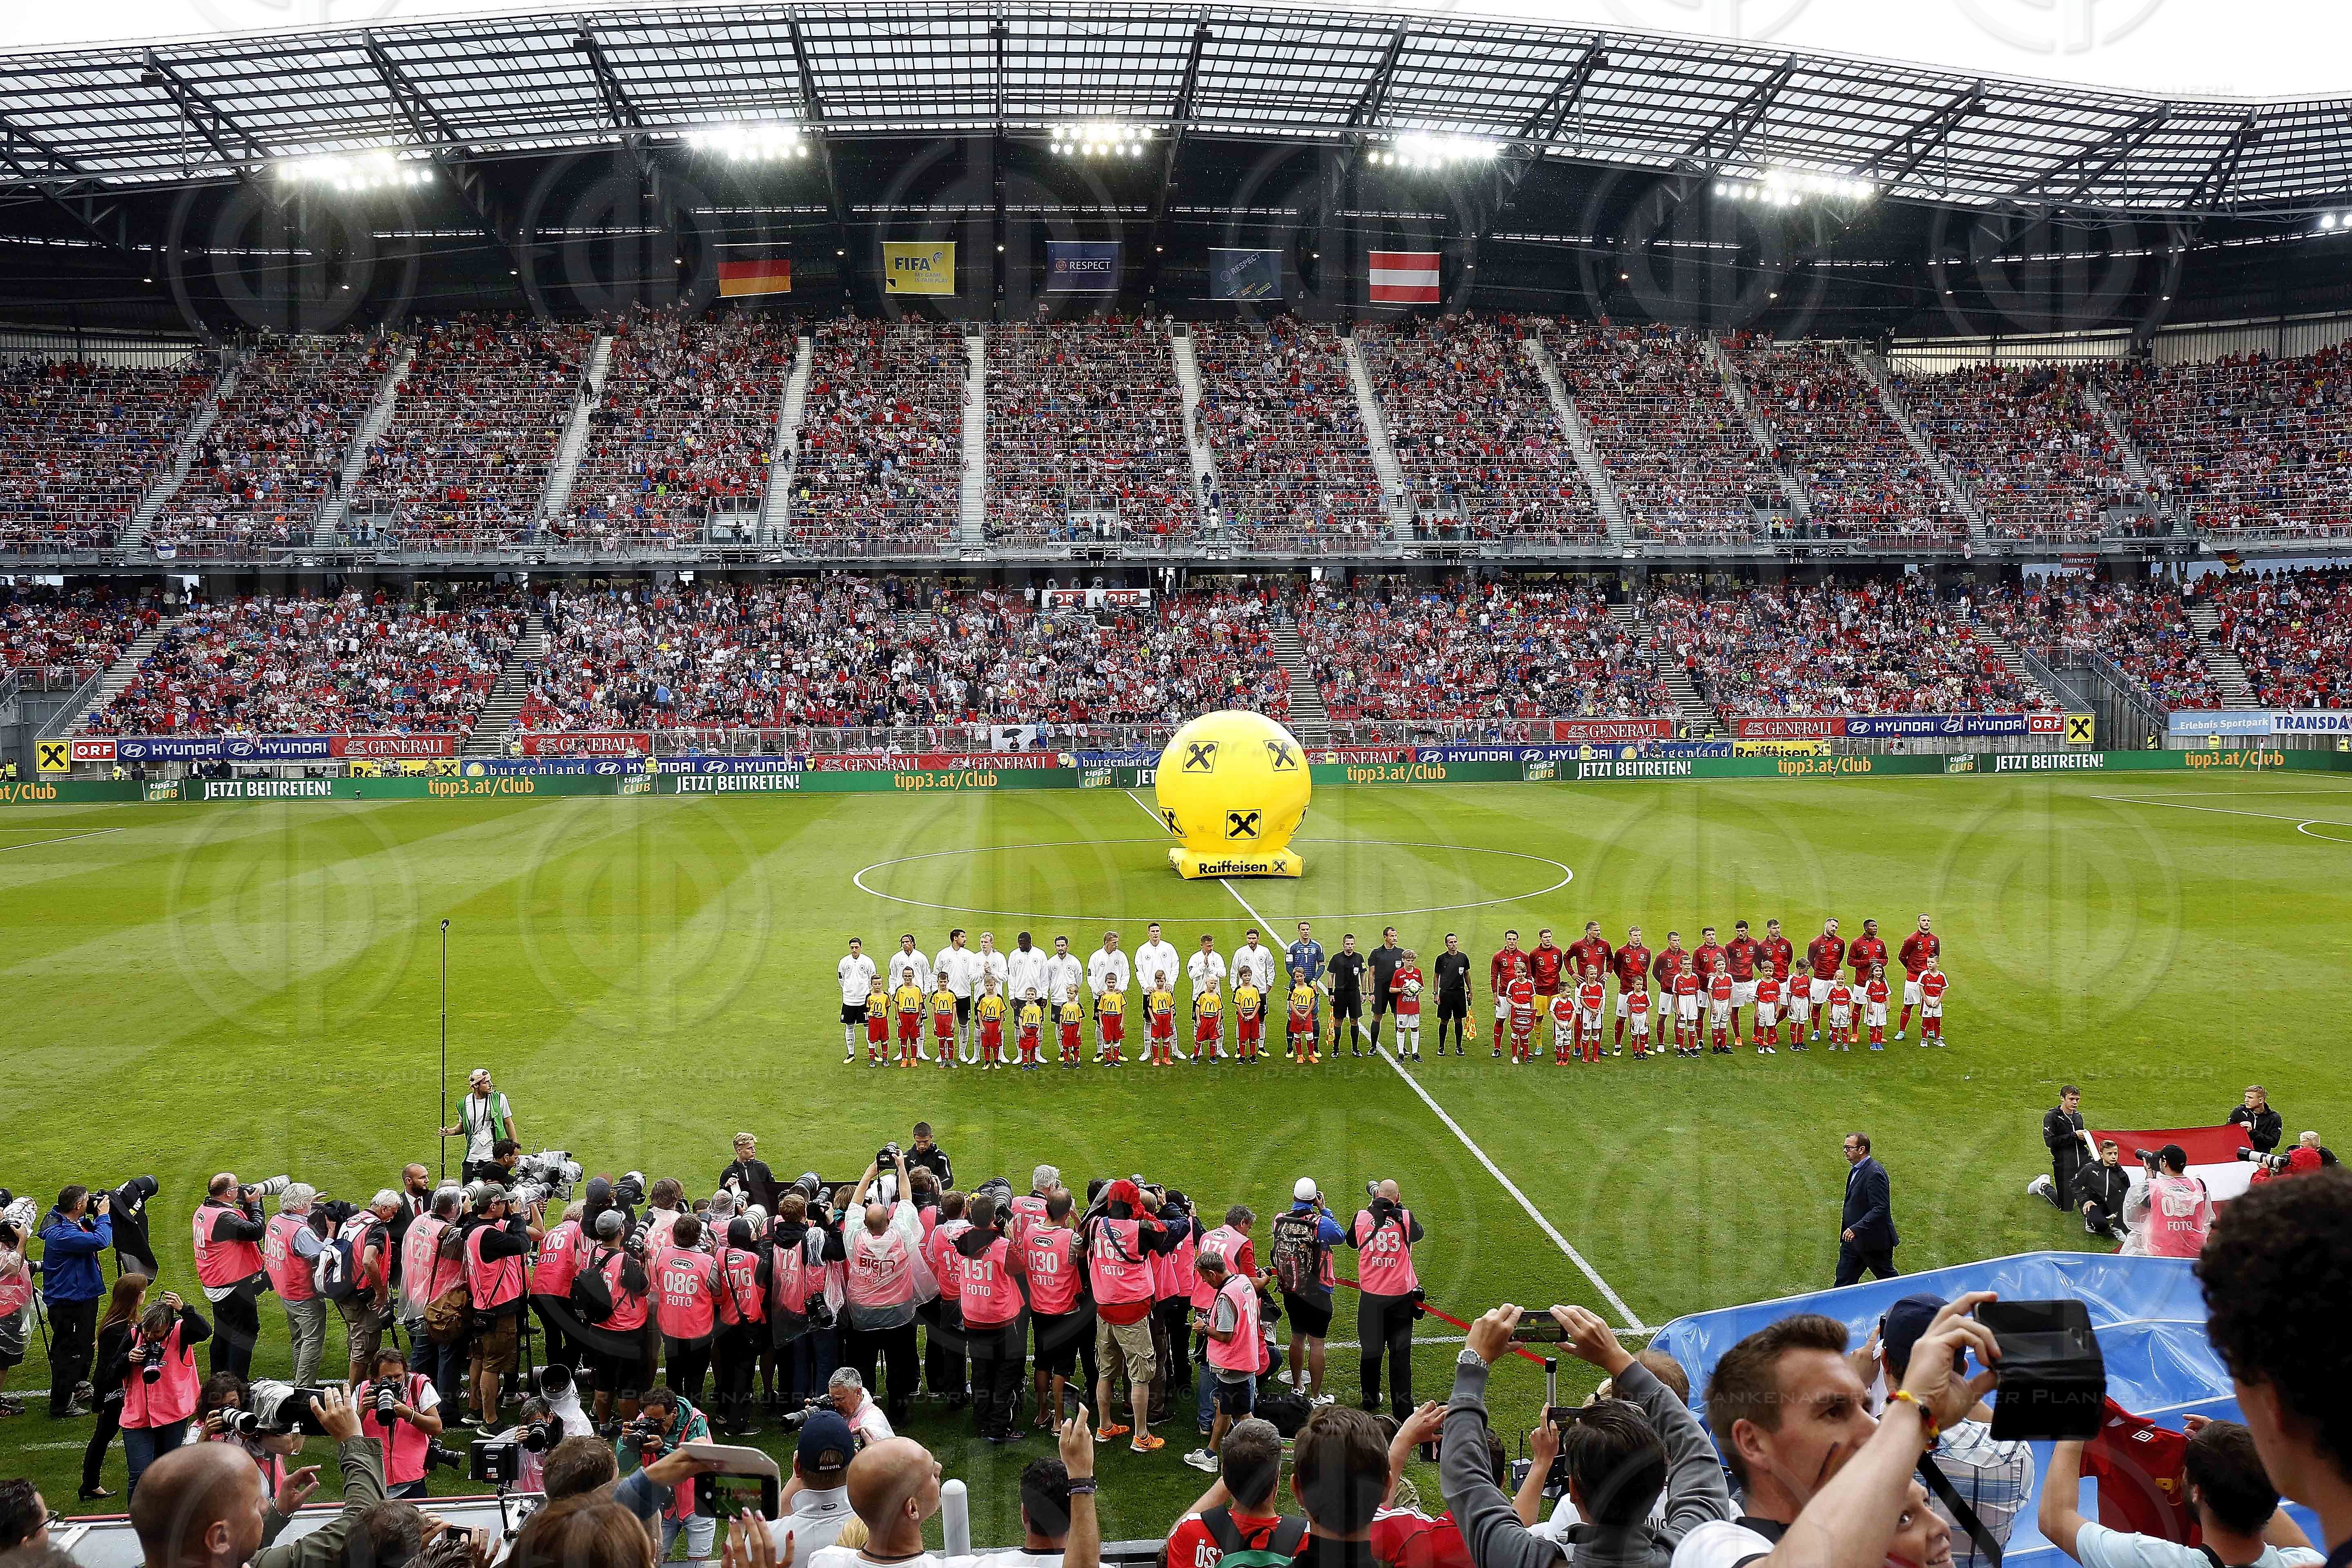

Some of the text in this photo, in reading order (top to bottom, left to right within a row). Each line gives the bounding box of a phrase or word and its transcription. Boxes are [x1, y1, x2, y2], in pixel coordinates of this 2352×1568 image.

[894, 257, 931, 271] FIFA
[1070, 261, 1111, 270] RESPECT
[1230, 252, 1261, 275] RESPECT
[1109, 594, 1138, 603] ORF
[1766, 722, 1832, 735] GENERALI
[1875, 722, 1934, 732] HYUNDAI
[1967, 720, 2026, 731] HYUNDAI
[2033, 720, 2063, 729] ORF
[2220, 718, 2269, 731] Sportpark
[1589, 724, 1658, 738] GENERALI
[77, 745, 113, 755] ORF
[152, 743, 222, 755] HYUNDAI
[259, 742, 327, 754] HYUNDAI
[368, 739, 443, 754] GENERALI
[1449, 751, 1513, 762] HYUNDAI
[1549, 749, 1613, 760] HYUDAI
[1949, 754, 1974, 763] tipp3
[972, 756, 1047, 769] GENERALI
[1082, 756, 1150, 768] burgenland
[1529, 760, 1555, 769] tipp3
[1949, 762, 1974, 772] CLUB
[1995, 753, 2104, 773] JETZT BEITRETEN!
[489, 763, 585, 776] burgenland
[1085, 768, 1111, 777] tipp3
[1347, 763, 1446, 784] tipp3.at/Club
[1529, 769, 1555, 780] CLUB
[1577, 760, 1693, 780] JETZT BEITRETEN!
[149, 780, 178, 790] tipp3
[623, 775, 651, 784] tipp3
[675, 774, 800, 795] JETZT BEITRETEN!
[894, 770, 998, 791] tipp3.at/Club
[1084, 776, 1111, 787] CLUB
[203, 780, 332, 800] JETZT BEITRETEN!
[428, 776, 535, 797] tipp3.at/Club
[623, 783, 651, 794] CLUB
[149, 789, 178, 800] CLUB
[1198, 860, 1268, 875] Raiffeisen
[2167, 1221, 2193, 1231] FOTO
[1366, 1231, 1401, 1253] 183
[859, 1257, 879, 1269] BIG
[1027, 1250, 1058, 1274] 030
[1372, 1256, 1396, 1268] FOTO
[961, 1259, 993, 1281] 151
[1100, 1264, 1125, 1276] FOTO
[664, 1271, 699, 1295] 086
[1032, 1274, 1055, 1286] FOTO
[967, 1283, 991, 1297] FOTO
[666, 1294, 693, 1307] FOTO
